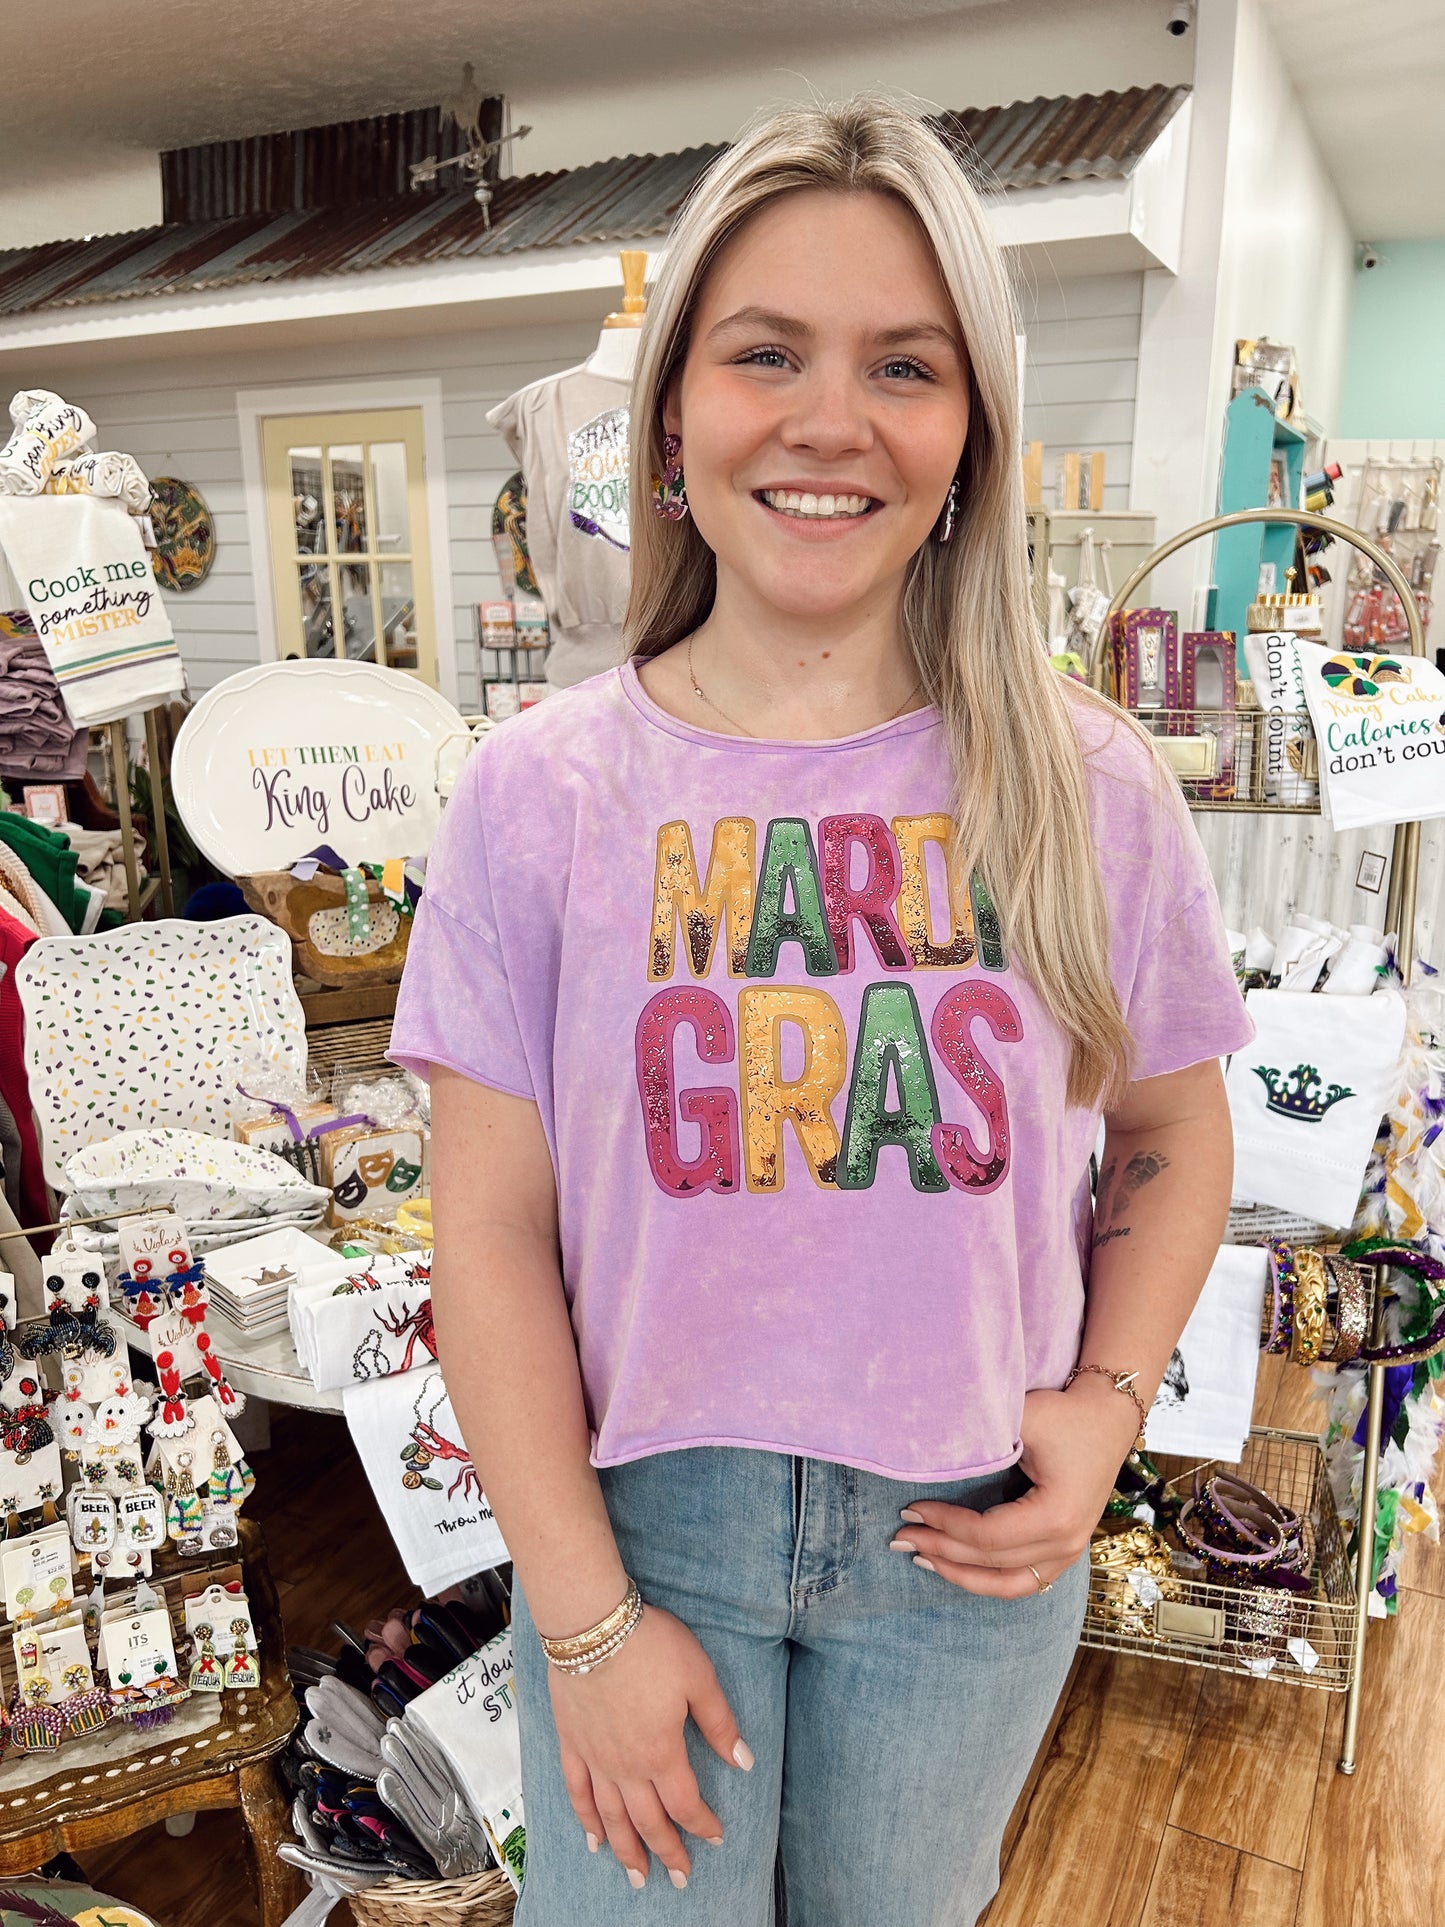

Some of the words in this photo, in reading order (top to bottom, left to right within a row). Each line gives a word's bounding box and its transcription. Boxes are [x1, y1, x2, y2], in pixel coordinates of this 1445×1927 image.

[29, 567, 101, 602] Cook
[104, 561, 147, 582] me
[40, 587, 154, 635] something
[52, 608, 140, 645] MISTER
[1322, 700, 1383, 722] King
[1390, 688, 1441, 705] Cake
[1328, 717, 1434, 752] Calories
[248, 747, 290, 767] LET
[295, 745, 361, 765] THEM
[364, 742, 405, 763] EAT
[252, 767, 331, 834] King
[342, 764, 416, 822] Cake
[635, 980, 1024, 1198] GRAS
[125, 1499, 157, 1514] BEER
[434, 1515, 478, 1535] Throw
[128, 1633, 149, 1648] ITS
[456, 1672, 476, 1705] it
